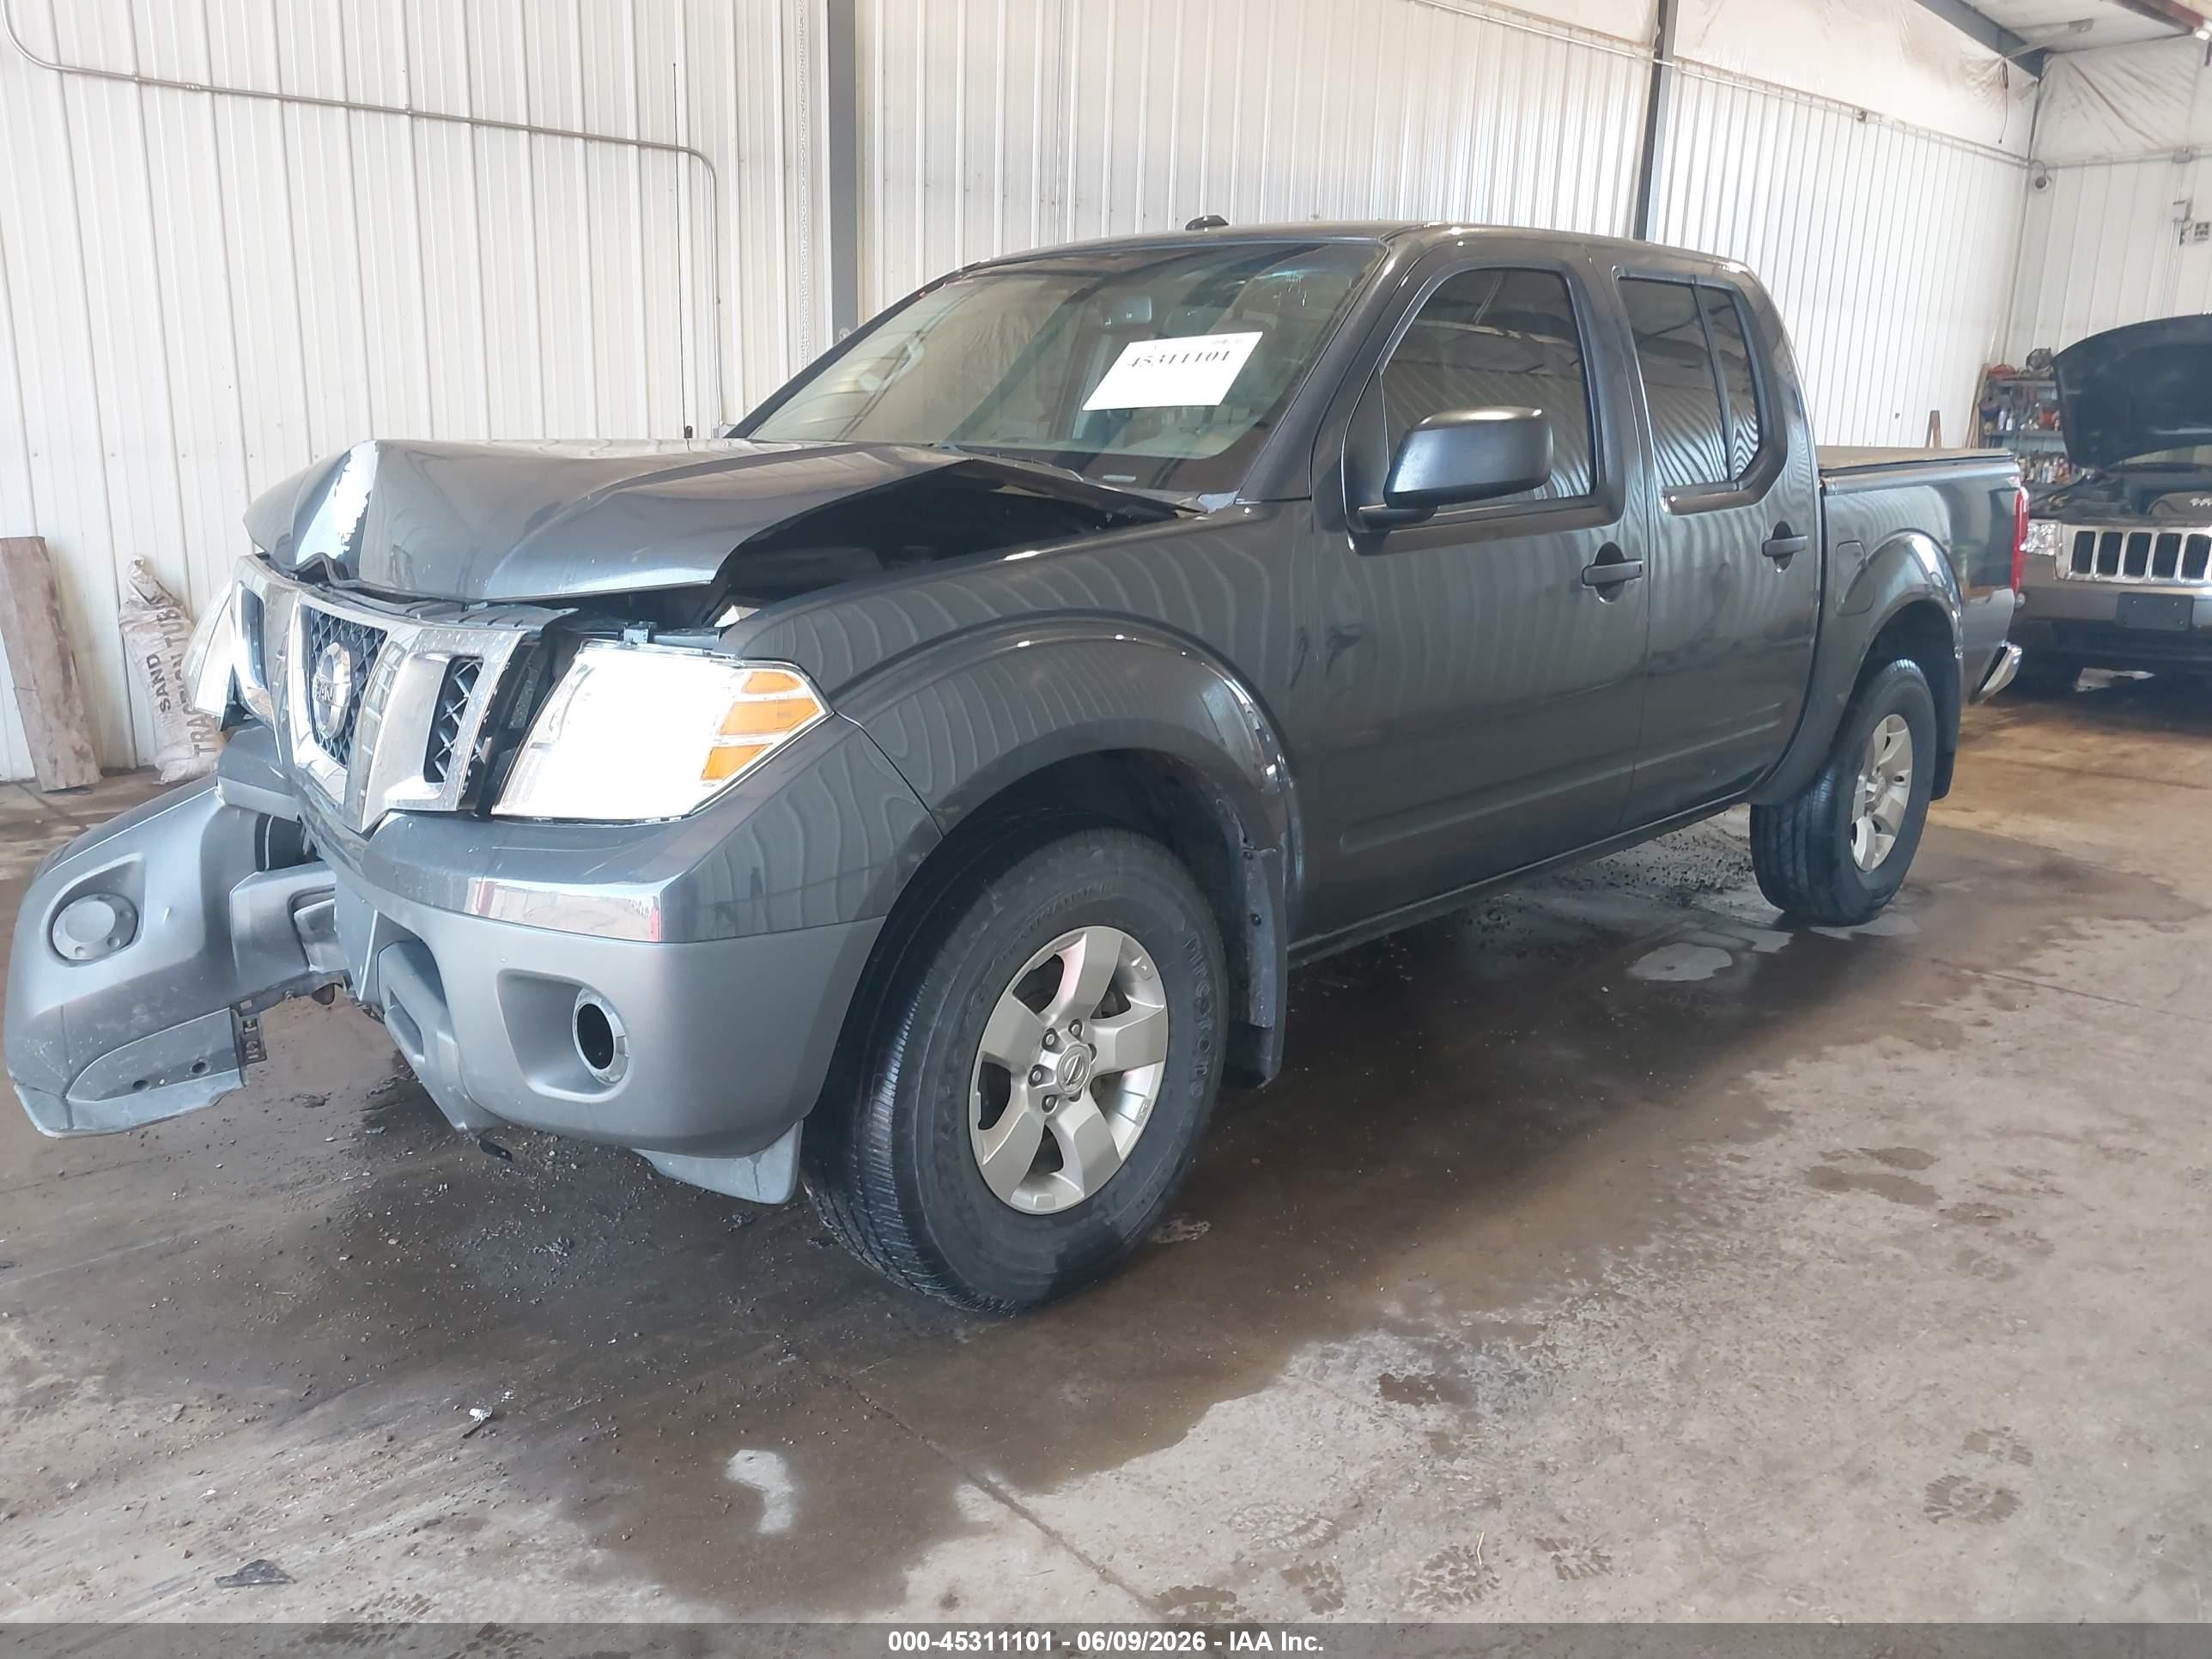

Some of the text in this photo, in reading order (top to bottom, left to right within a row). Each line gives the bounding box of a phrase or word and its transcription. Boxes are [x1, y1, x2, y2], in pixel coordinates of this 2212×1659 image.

[147, 654, 172, 714] SAND
[155, 597, 217, 757] TRACN TUB
